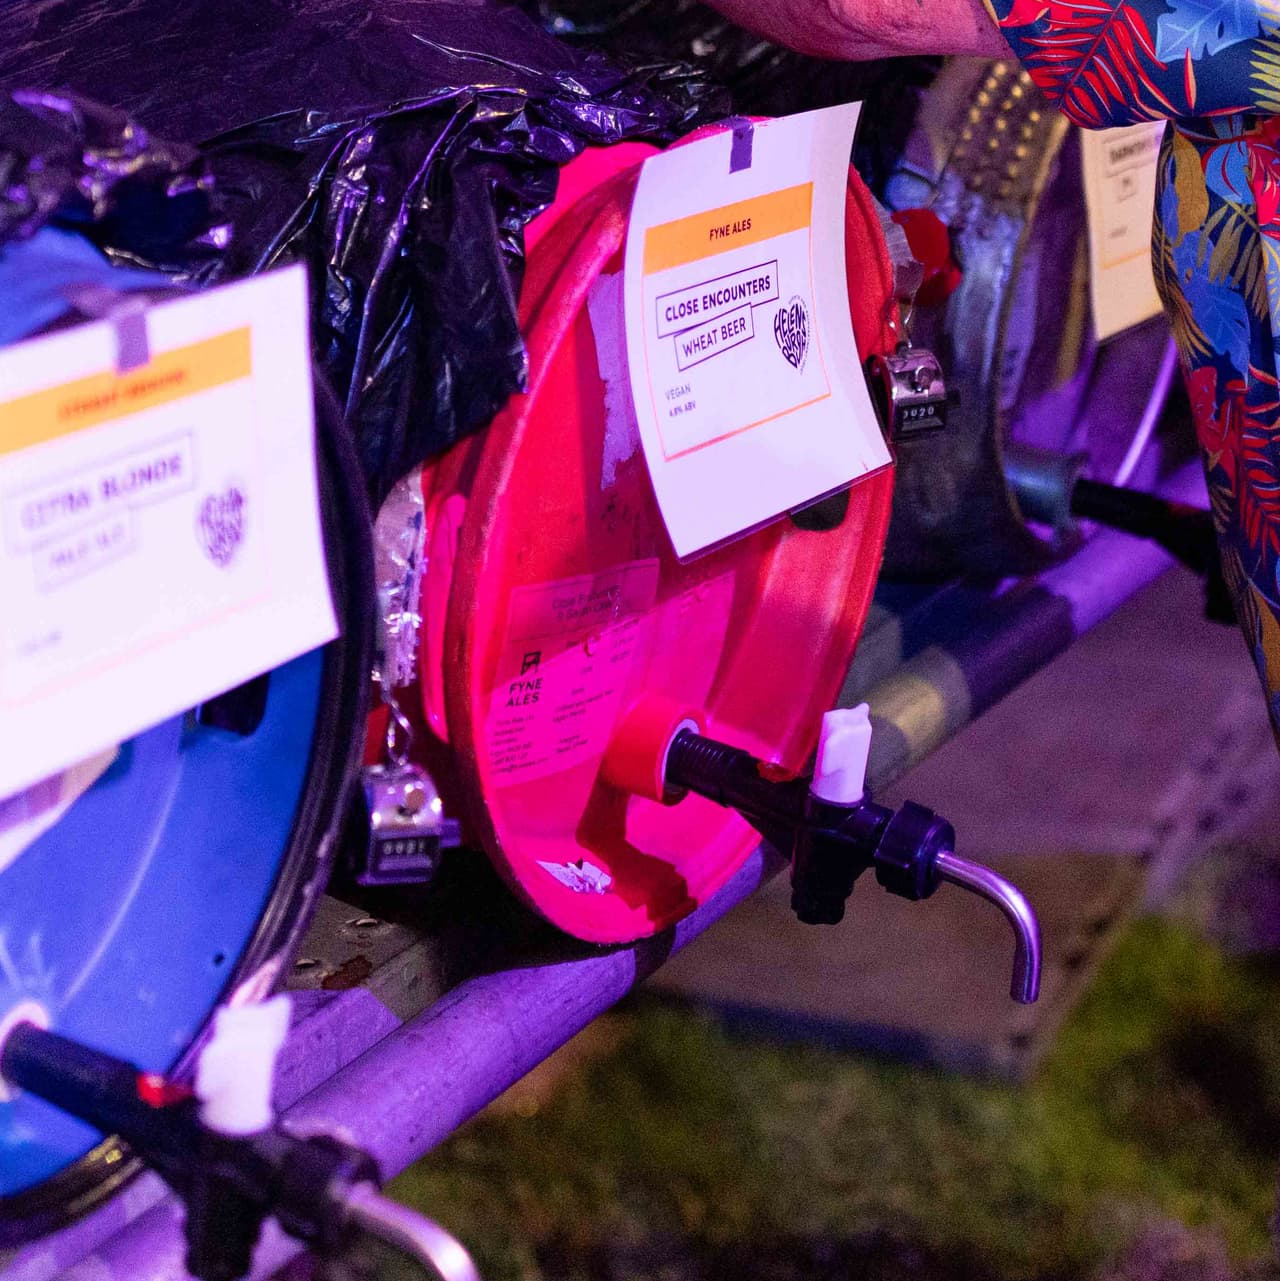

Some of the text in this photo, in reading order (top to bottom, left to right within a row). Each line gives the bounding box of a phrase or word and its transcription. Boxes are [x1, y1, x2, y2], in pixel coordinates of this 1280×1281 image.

[709, 218, 752, 241] FYNE ALES
[665, 275, 771, 322] CLOSE ENCOUNTERS
[682, 316, 747, 358] WHEAT BEER
[664, 383, 691, 401] VEGAN
[508, 677, 543, 694] FYNE
[504, 691, 540, 708] ALES
